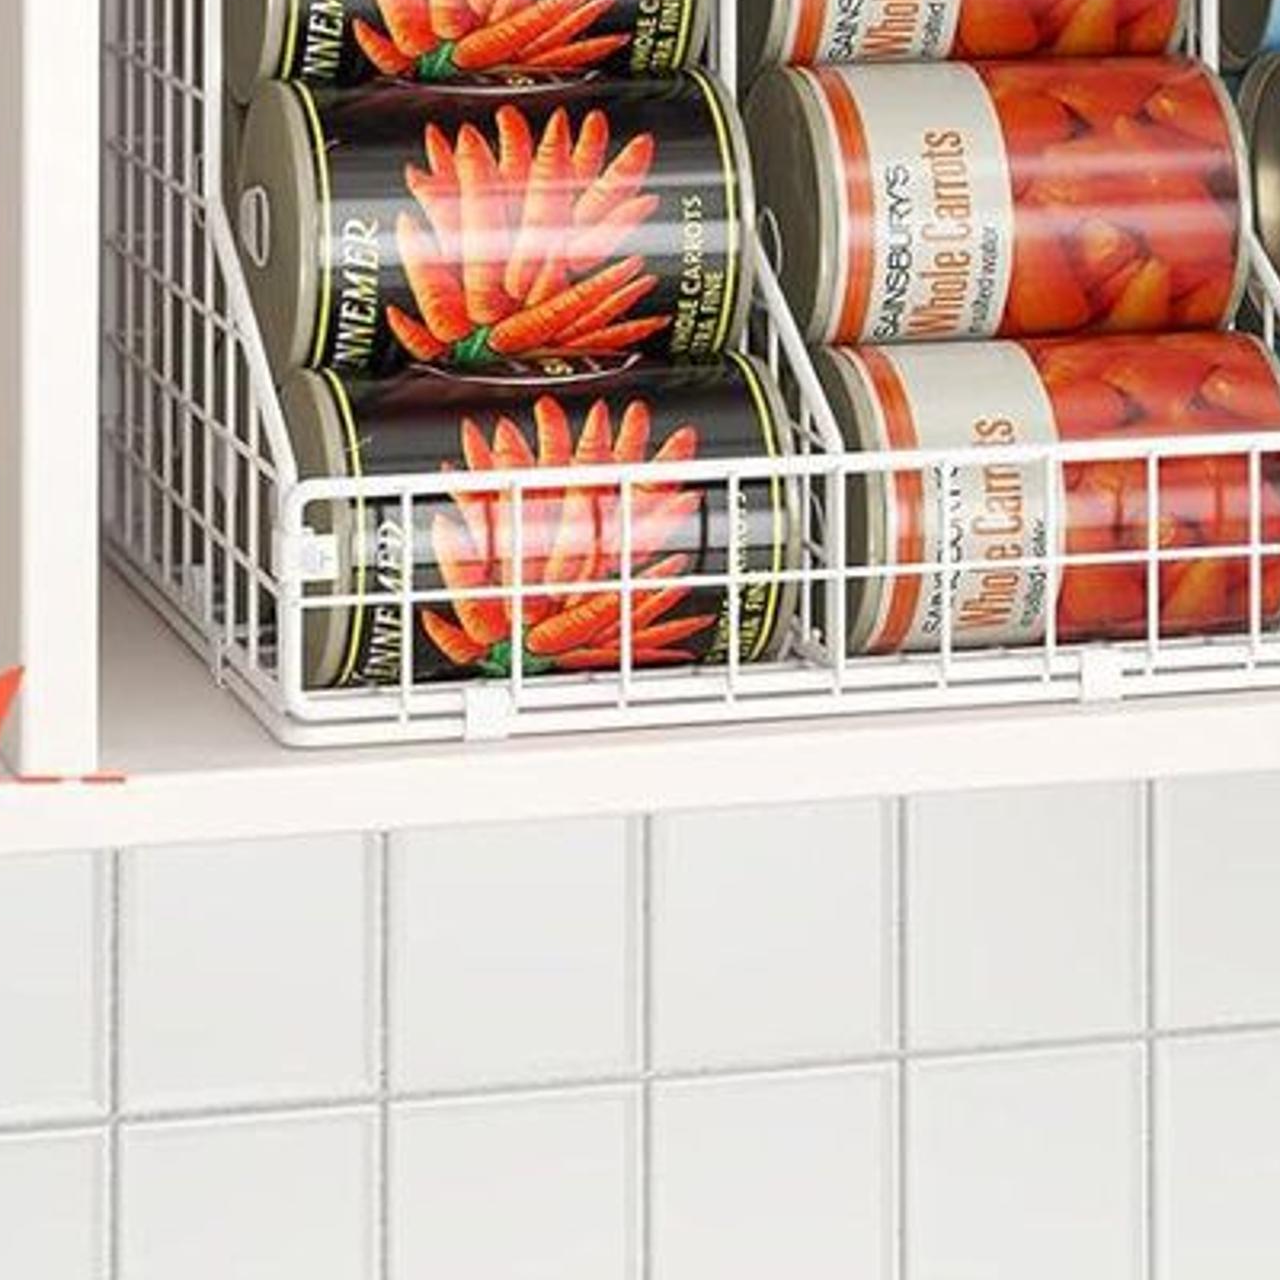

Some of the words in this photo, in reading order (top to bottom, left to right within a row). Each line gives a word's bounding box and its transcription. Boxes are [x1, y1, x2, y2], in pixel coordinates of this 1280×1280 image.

[922, 130, 972, 242] Carrots
[332, 217, 381, 367] NNEMER
[680, 193, 703, 296] CARROTS
[905, 250, 971, 338] Whole
